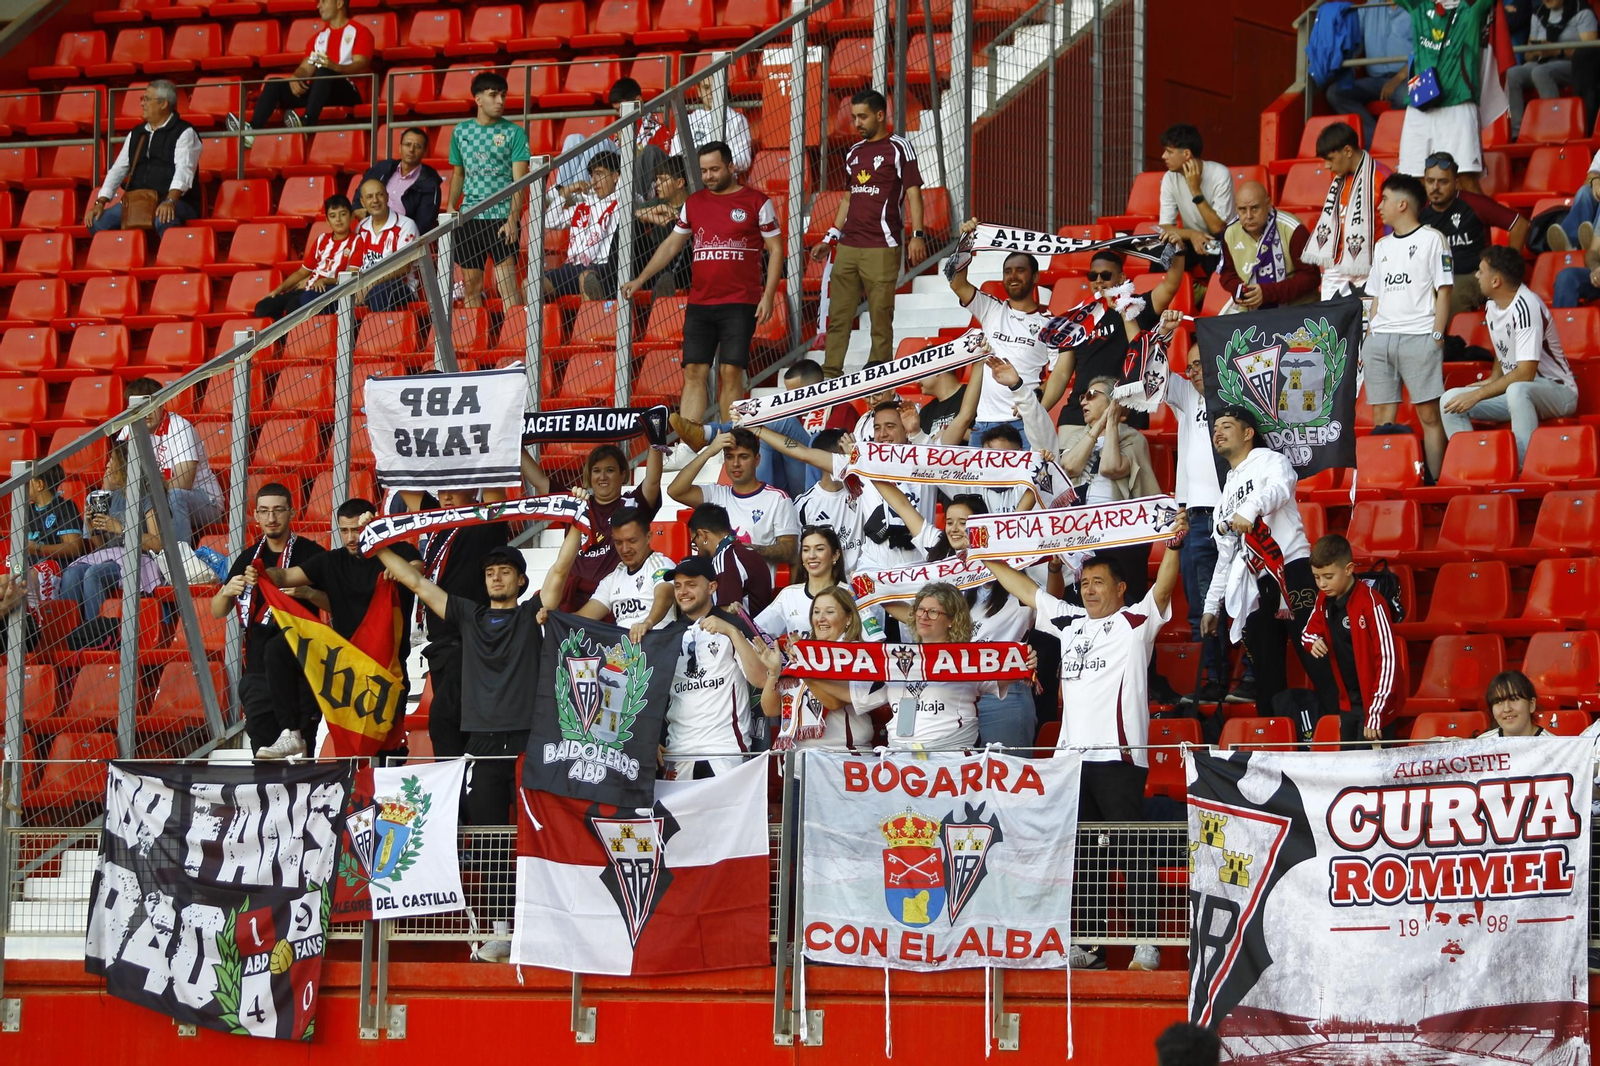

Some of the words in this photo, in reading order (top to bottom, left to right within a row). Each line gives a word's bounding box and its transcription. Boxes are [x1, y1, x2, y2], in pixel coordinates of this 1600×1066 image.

[992, 331, 1035, 347] SOLISS
[770, 372, 861, 407] ALBACETE
[865, 343, 955, 382] BALOMPIÉ
[926, 448, 1033, 472] BOGARRA
[910, 469, 936, 479] Andrés
[994, 516, 1044, 540] PEÑA
[1048, 504, 1149, 537] BOGARRA
[1037, 540, 1061, 550] Andrés
[1287, 588, 1317, 611] 23
[790, 644, 878, 675] AUPA
[932, 646, 1028, 674] ALBA
[674, 676, 725, 694] Globalcaja
[568, 759, 607, 784] ABP
[843, 757, 1045, 798] BOGARRA
[1393, 753, 1511, 778] ALBACETE
[1326, 772, 1581, 852] CURVA
[184, 781, 346, 888] FANS
[1328, 844, 1576, 907] ROMMEL
[376, 896, 399, 910] DEL
[402, 891, 458, 907] CASTILLO
[1398, 918, 1420, 937] 19
[1486, 915, 1509, 934] 98
[804, 921, 888, 957] CON
[900, 930, 947, 963] EL
[954, 927, 1066, 958] ALBA
[244, 953, 269, 975] ABP
[294, 936, 323, 960] FANS
